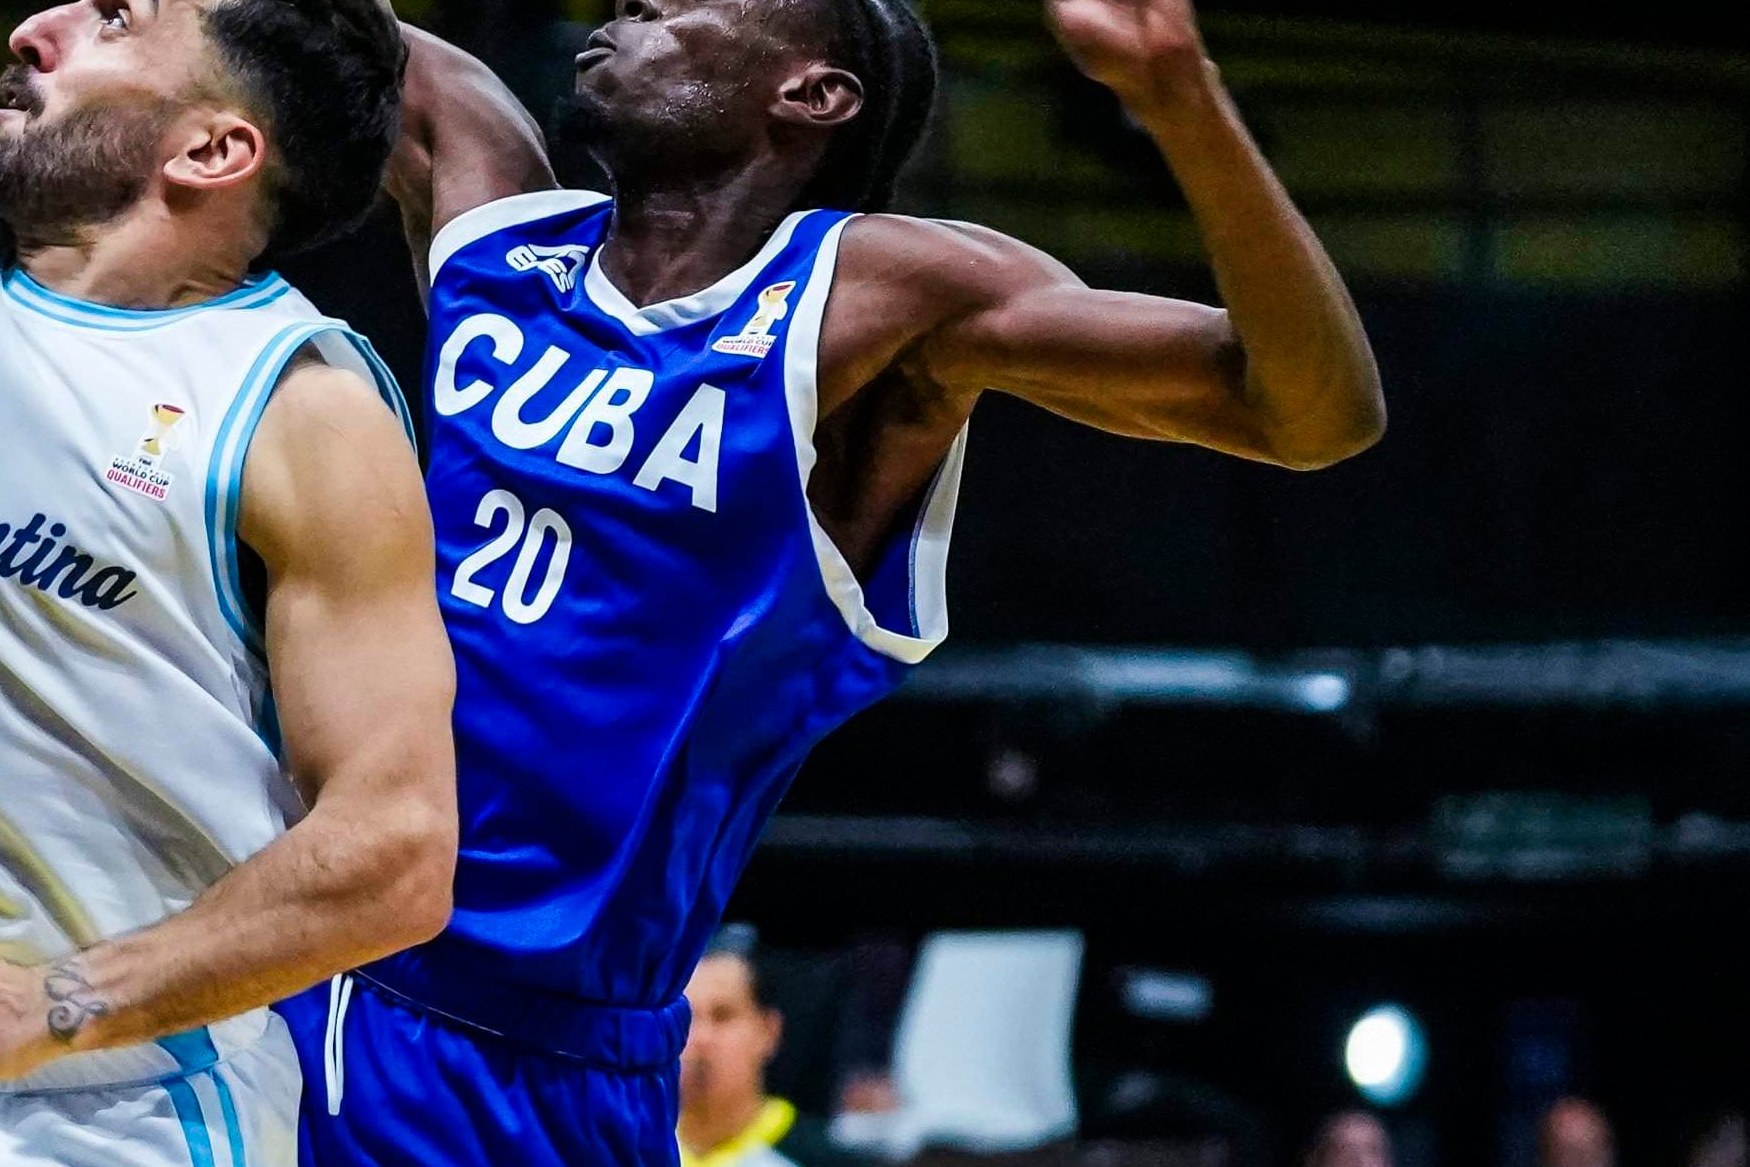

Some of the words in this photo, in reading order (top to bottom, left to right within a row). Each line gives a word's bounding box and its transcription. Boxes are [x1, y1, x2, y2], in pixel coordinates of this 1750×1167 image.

[434, 312, 727, 514] CUBA
[107, 470, 166, 498] QUALIFIERS
[112, 461, 148, 480] WORLD
[149, 475, 170, 487] CUP
[451, 489, 573, 625] 20
